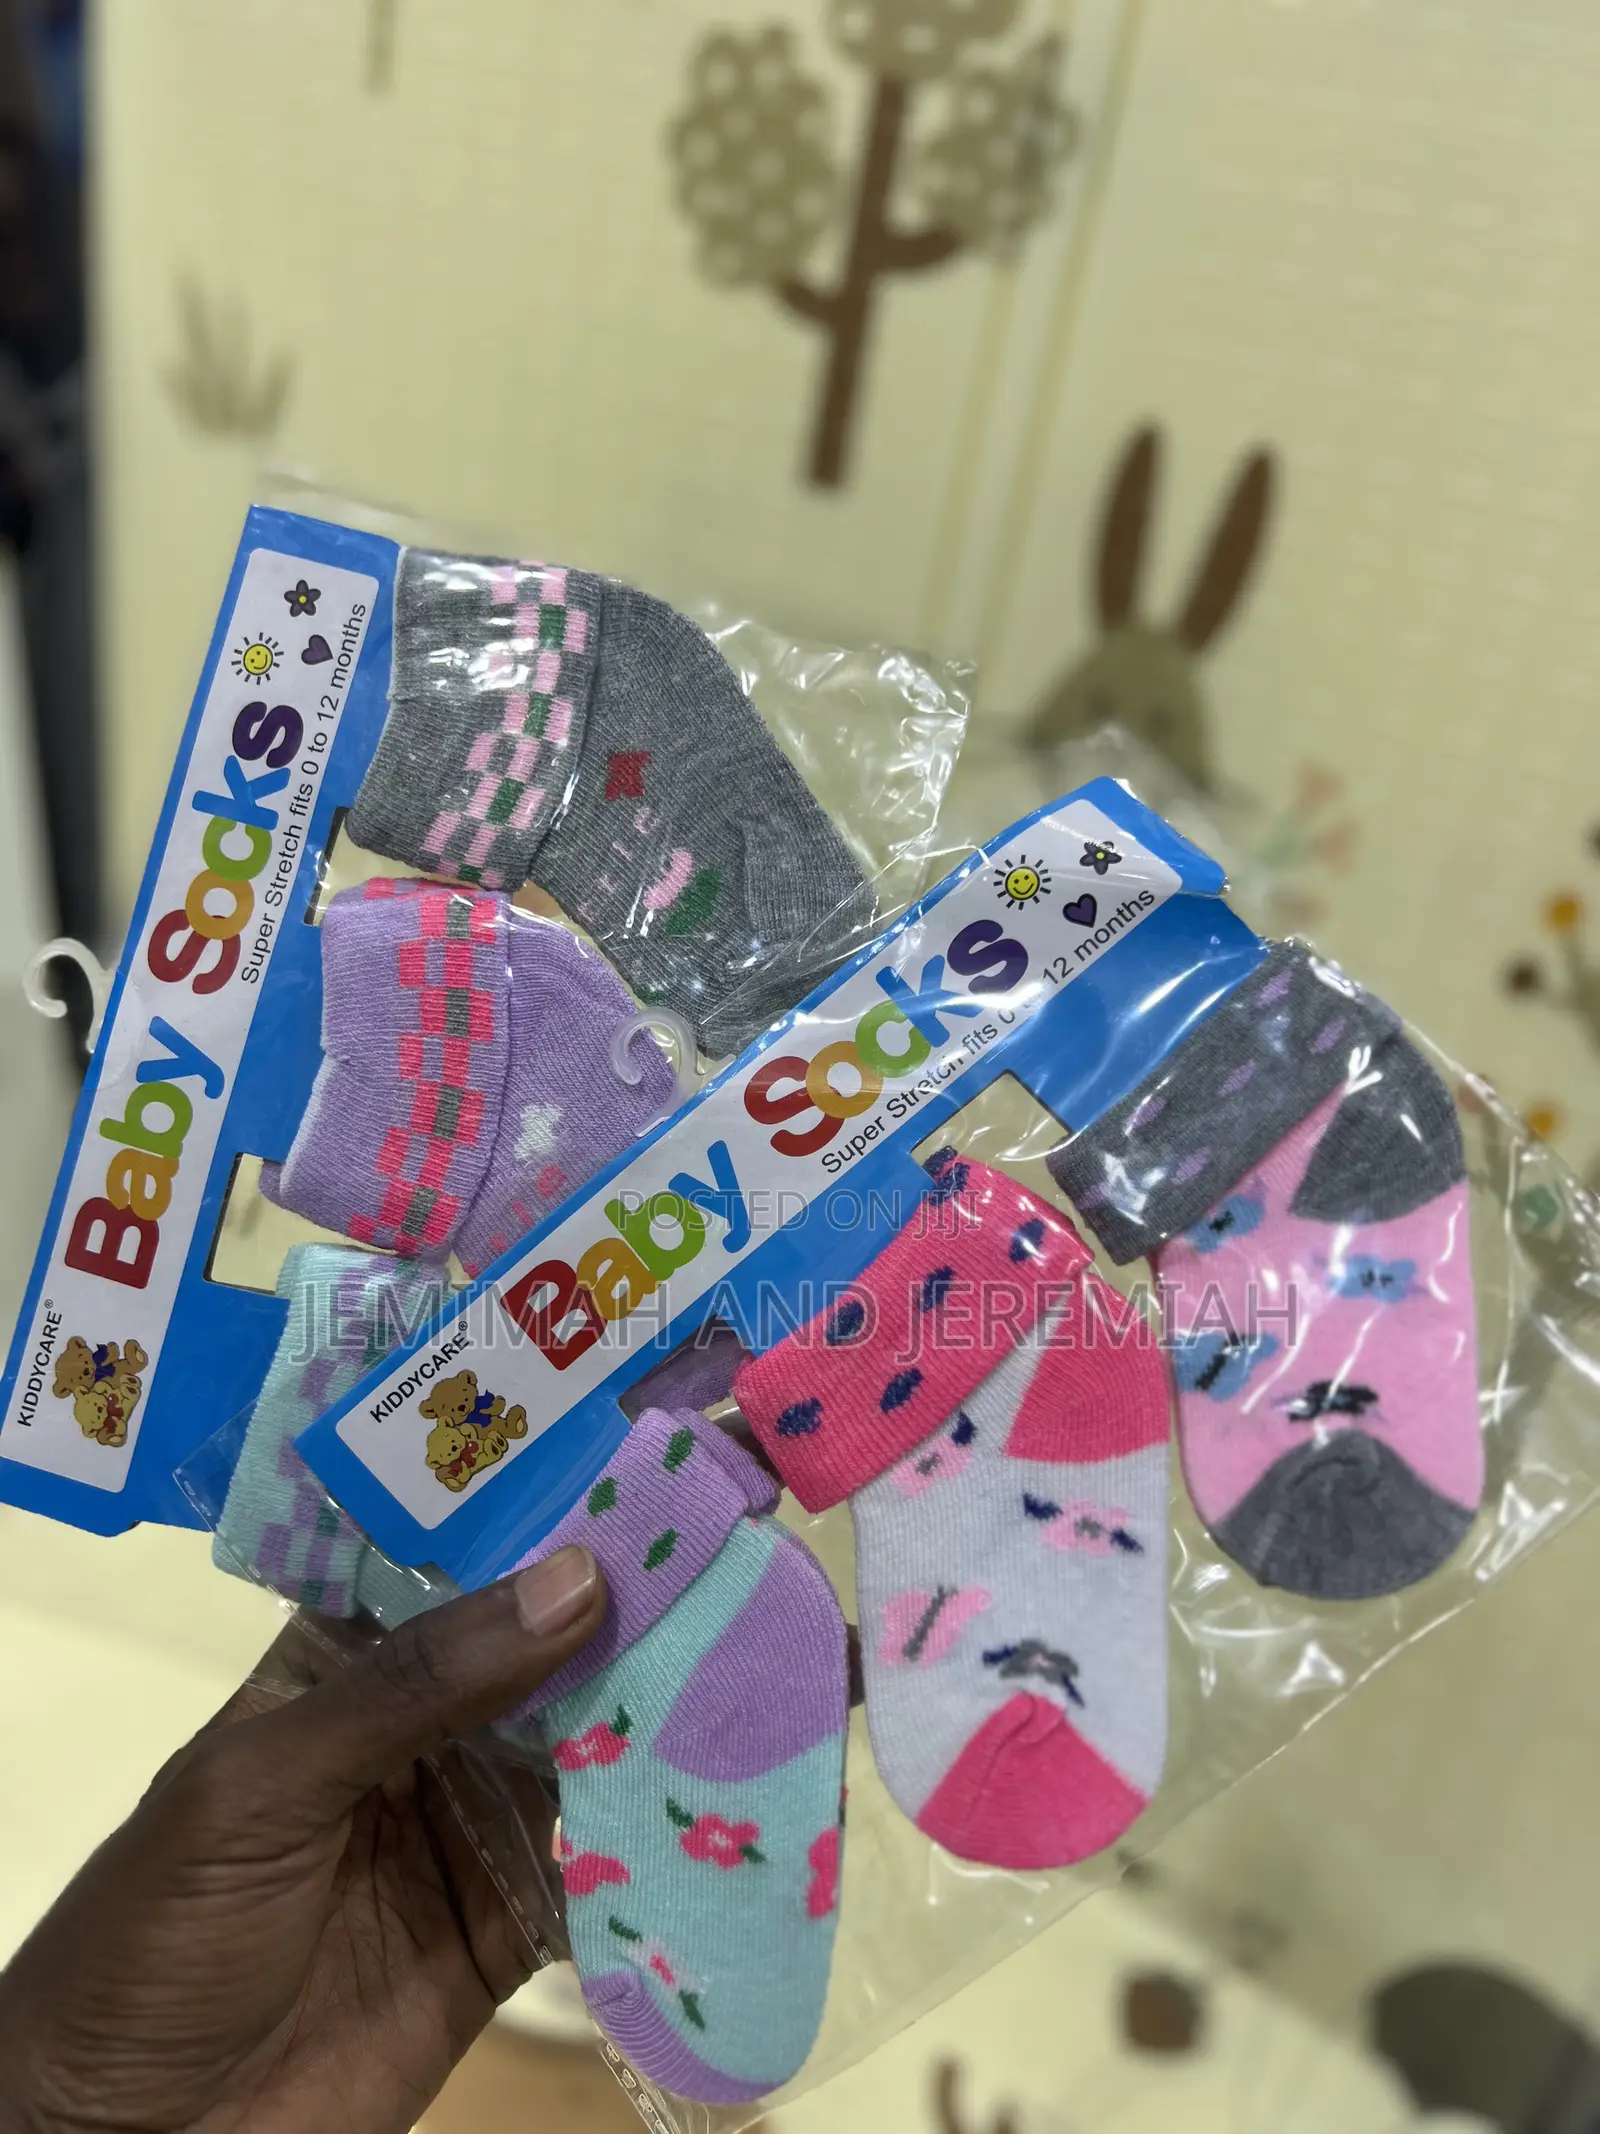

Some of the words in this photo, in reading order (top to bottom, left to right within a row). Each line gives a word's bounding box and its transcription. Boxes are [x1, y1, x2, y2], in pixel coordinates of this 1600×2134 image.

[330, 604, 366, 689] months
[308, 732, 328, 753] to
[317, 695, 339, 721] 12
[290, 782, 314, 818] fits
[301, 760, 319, 775] 0
[265, 823, 303, 907] Stretch
[241, 914, 276, 984] Super
[65, 1016, 224, 1289] Baby
[147, 701, 304, 995] Socks
[821, 1116, 886, 1174] Super
[962, 1024, 998, 1056] fits
[1043, 957, 1075, 986] 12
[1073, 889, 1156, 963] months
[500, 1141, 751, 1371] Baby
[743, 919, 1029, 1158] Socks
